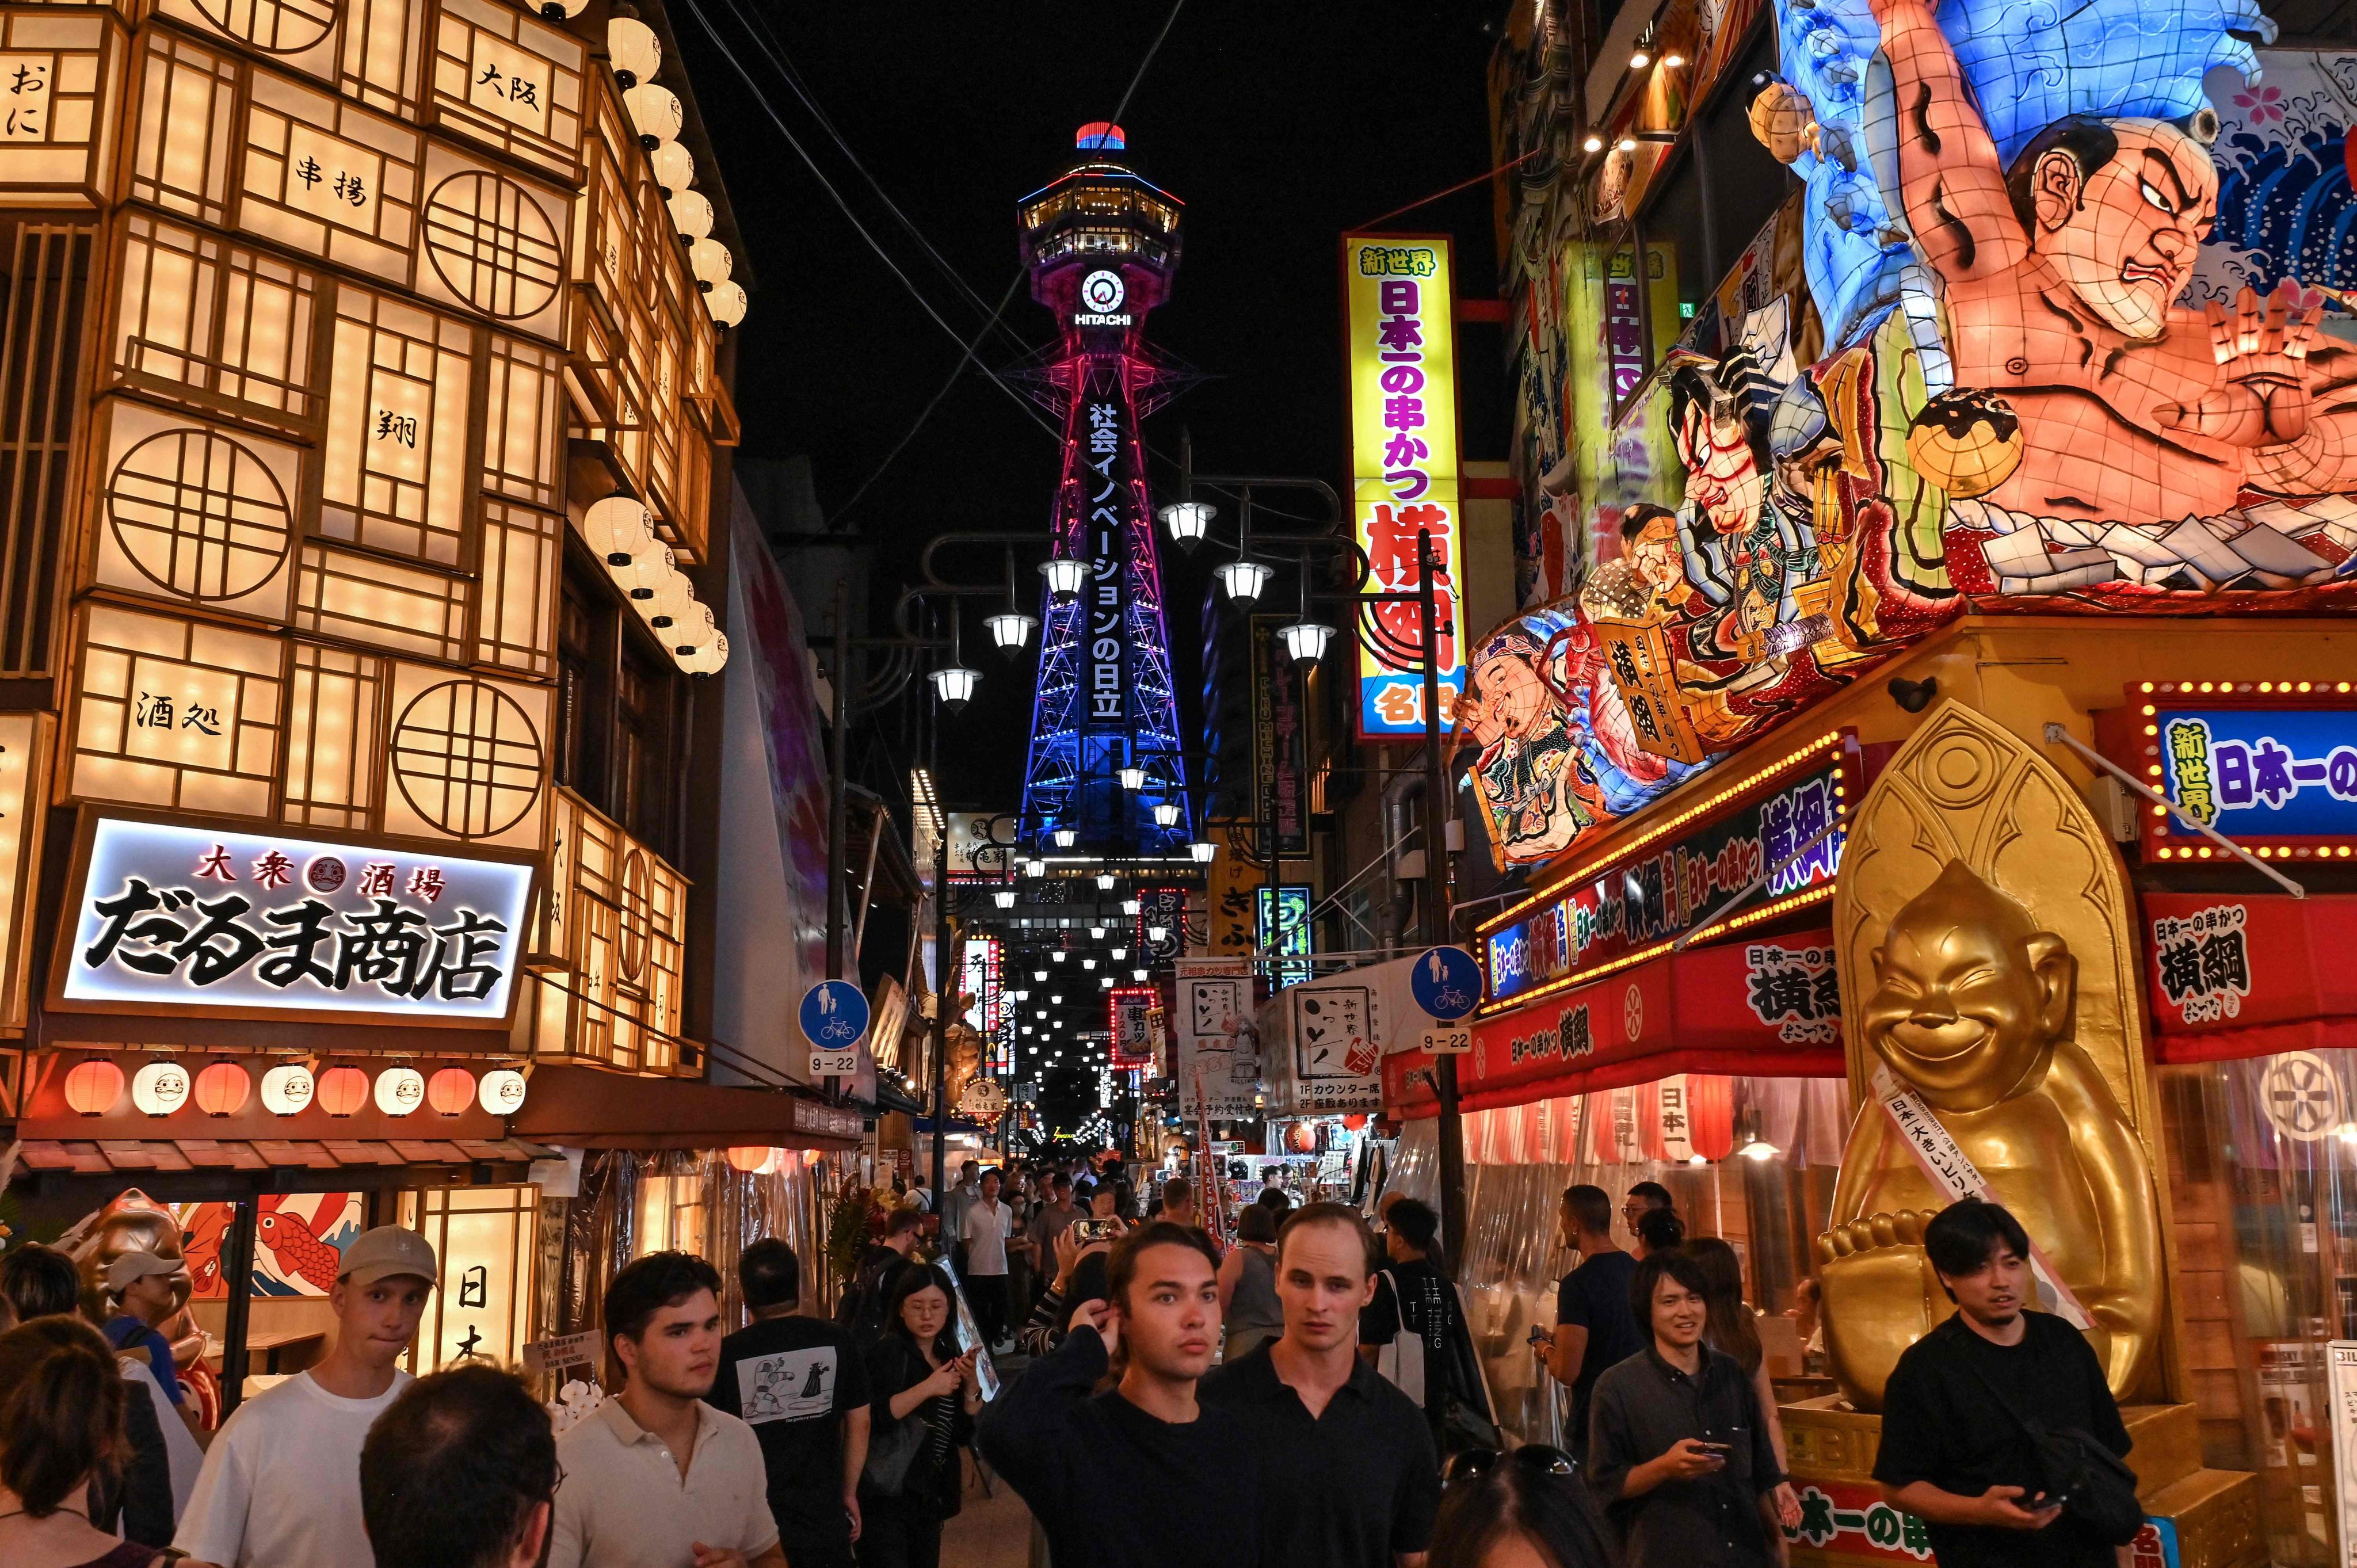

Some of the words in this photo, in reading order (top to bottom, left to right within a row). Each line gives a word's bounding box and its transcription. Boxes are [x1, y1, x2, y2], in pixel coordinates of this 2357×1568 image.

[476, 64, 540, 113] 大阪
[296, 156, 367, 207] 串揚
[1361, 248, 1436, 276] 新世界
[1075, 315, 1130, 325] HITACHI
[1379, 281, 1428, 499] 日本一の串かつ
[377, 409, 417, 449] 翔
[1090, 404, 1121, 716] 社会イノベーションの日立
[1367, 505, 1454, 672] 横綱
[136, 691, 222, 735] 酒処
[1379, 686, 1455, 722] 名門
[1608, 639, 1661, 742] 横綱
[1635, 635, 1679, 757] 日本一の串かつ
[2171, 722, 2214, 824] 新世界
[2215, 741, 2357, 804] 日本一の
[1688, 841, 1760, 906] 日本一の串かつ
[1761, 783, 1829, 892] 横綱
[199, 844, 295, 884] 大衆
[360, 862, 445, 903] 酒場
[1220, 887, 1254, 956] ぎふ
[1577, 899, 1622, 944] 日本一の串かつ
[1624, 858, 1664, 943] 横綱
[1664, 856, 1677, 930] 名門
[2157, 909, 2244, 941] 日本一の串かつ
[84, 879, 508, 1002] だるま商店
[1530, 911, 1558, 979] 横綱
[1558, 909, 1567, 966] 名門
[1750, 949, 1836, 966] 日本一の串
[2160, 930, 2247, 1001] 横綱
[1180, 967, 1249, 976] 元祖串カツ専門店
[1128, 1006, 1145, 1043] 串カツ
[1343, 999, 1359, 1035] 新世界
[1371, 989, 1380, 1041] 商標登録
[1512, 1031, 1557, 1062] 日本一の串かつ
[1559, 1006, 1588, 1057] 横綱
[813, 1056, 853, 1070] 9-22
[1424, 1034, 1469, 1048] 9-22
[1184, 1104, 1254, 1116] 宴会予約受付中
[1300, 1086, 1310, 1094] 1F
[1314, 1084, 1380, 1094] カウンター席
[1300, 1100, 1310, 1109] 2F
[1314, 1097, 1380, 1109] 座敷あります
[1910, 1094, 1926, 1115] BILLIKEN
[1923, 1112, 1945, 1135] DIVERSITY
[1662, 1088, 1686, 1143] 日本一
[1431, 1277, 1441, 1304] THE
[1782, 1491, 1931, 1555] 本一の串
